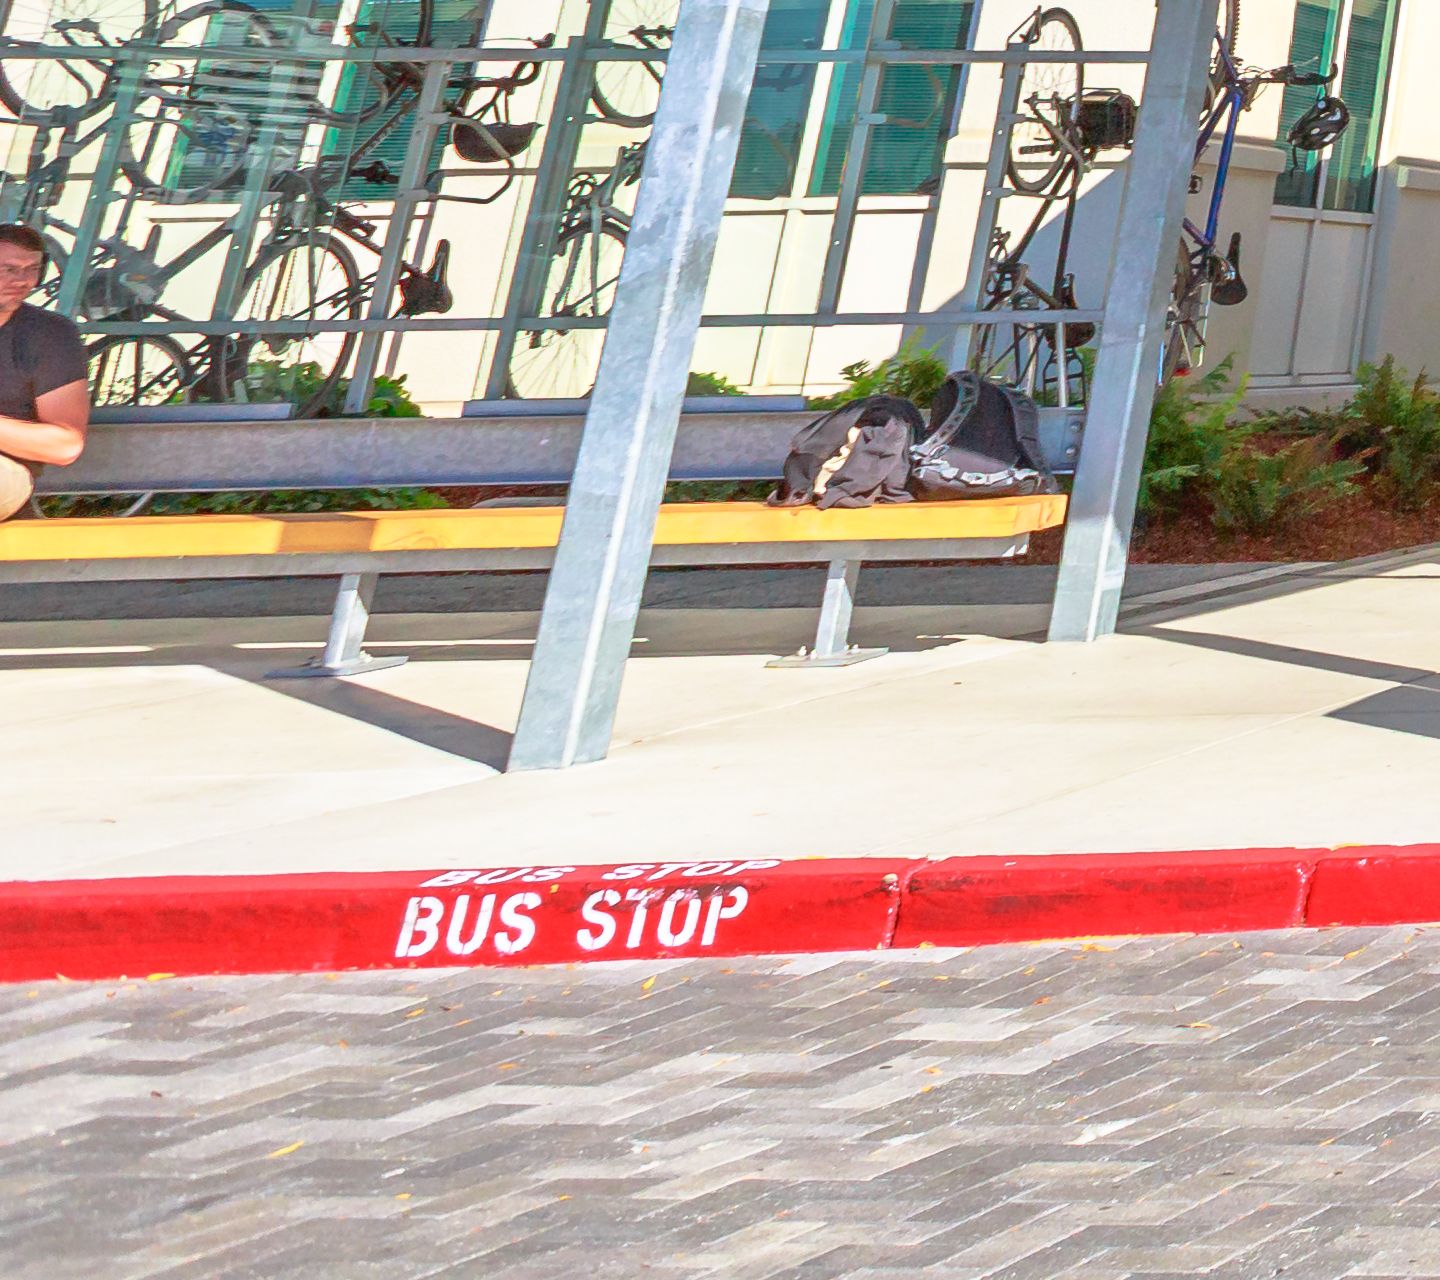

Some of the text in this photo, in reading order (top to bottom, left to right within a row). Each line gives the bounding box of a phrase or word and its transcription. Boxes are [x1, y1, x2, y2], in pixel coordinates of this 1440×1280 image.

[418, 859, 782, 888] BUS STOP
[394, 884, 748, 958] BUS STOP
